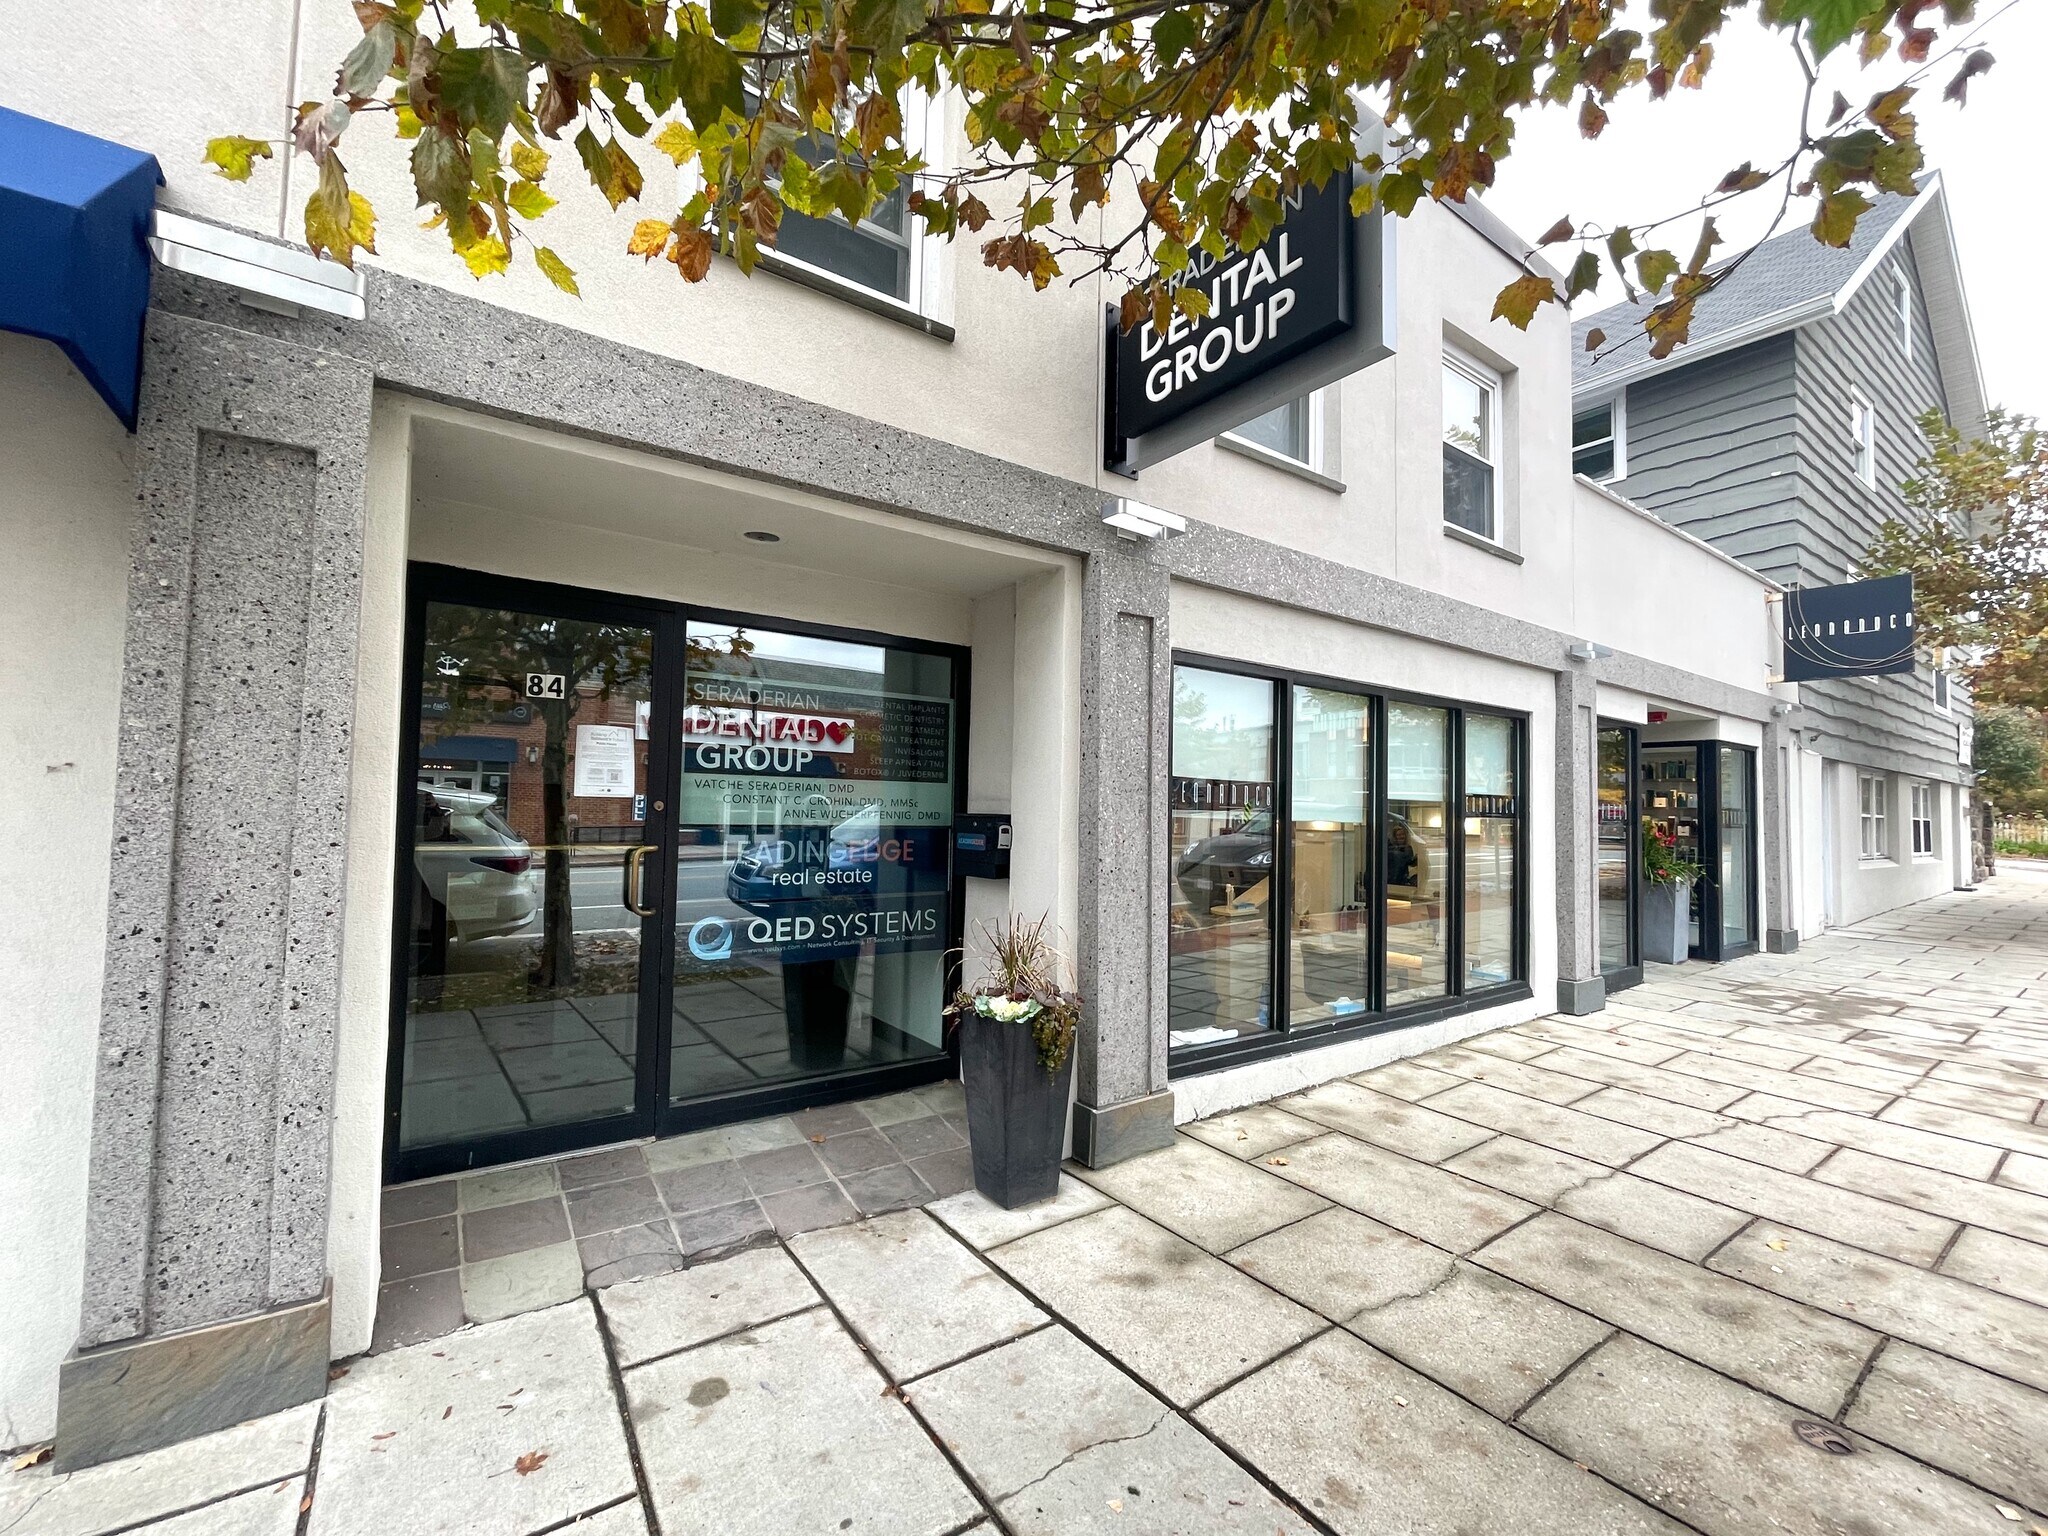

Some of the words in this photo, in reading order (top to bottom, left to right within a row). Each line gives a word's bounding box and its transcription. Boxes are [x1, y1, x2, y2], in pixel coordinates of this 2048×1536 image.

[1145, 288, 1296, 402] GROUP
[527, 674, 563, 698] 84
[693, 682, 820, 710] SERADERIAN
[874, 701, 906, 711] DENTAL
[907, 704, 946, 714] IMPLANTS
[691, 704, 819, 742] DENTAL
[904, 714, 946, 724] DENTISTRY
[878, 723, 898, 732] GUM
[900, 725, 946, 736] TREATMENT
[900, 736, 946, 747] TREATMENT
[695, 742, 814, 773] GROUP
[869, 756, 894, 766] SLEEP
[895, 757, 922, 767] APNEA
[694, 779, 744, 790] VATCHE
[748, 780, 826, 794] SERADERIAN,
[828, 783, 855, 794] DMD
[723, 793, 790, 805] CONSTANT
[793, 795, 805, 806] C.
[890, 798, 919, 808] MMSc
[783, 809, 817, 819] ANNE
[917, 811, 941, 820] DMD
[772, 868, 809, 886] real
[814, 868, 873, 884] estate
[747, 916, 815, 943] QED
[821, 908, 937, 939] SYSTEMS
[807, 941, 832, 949] Network
